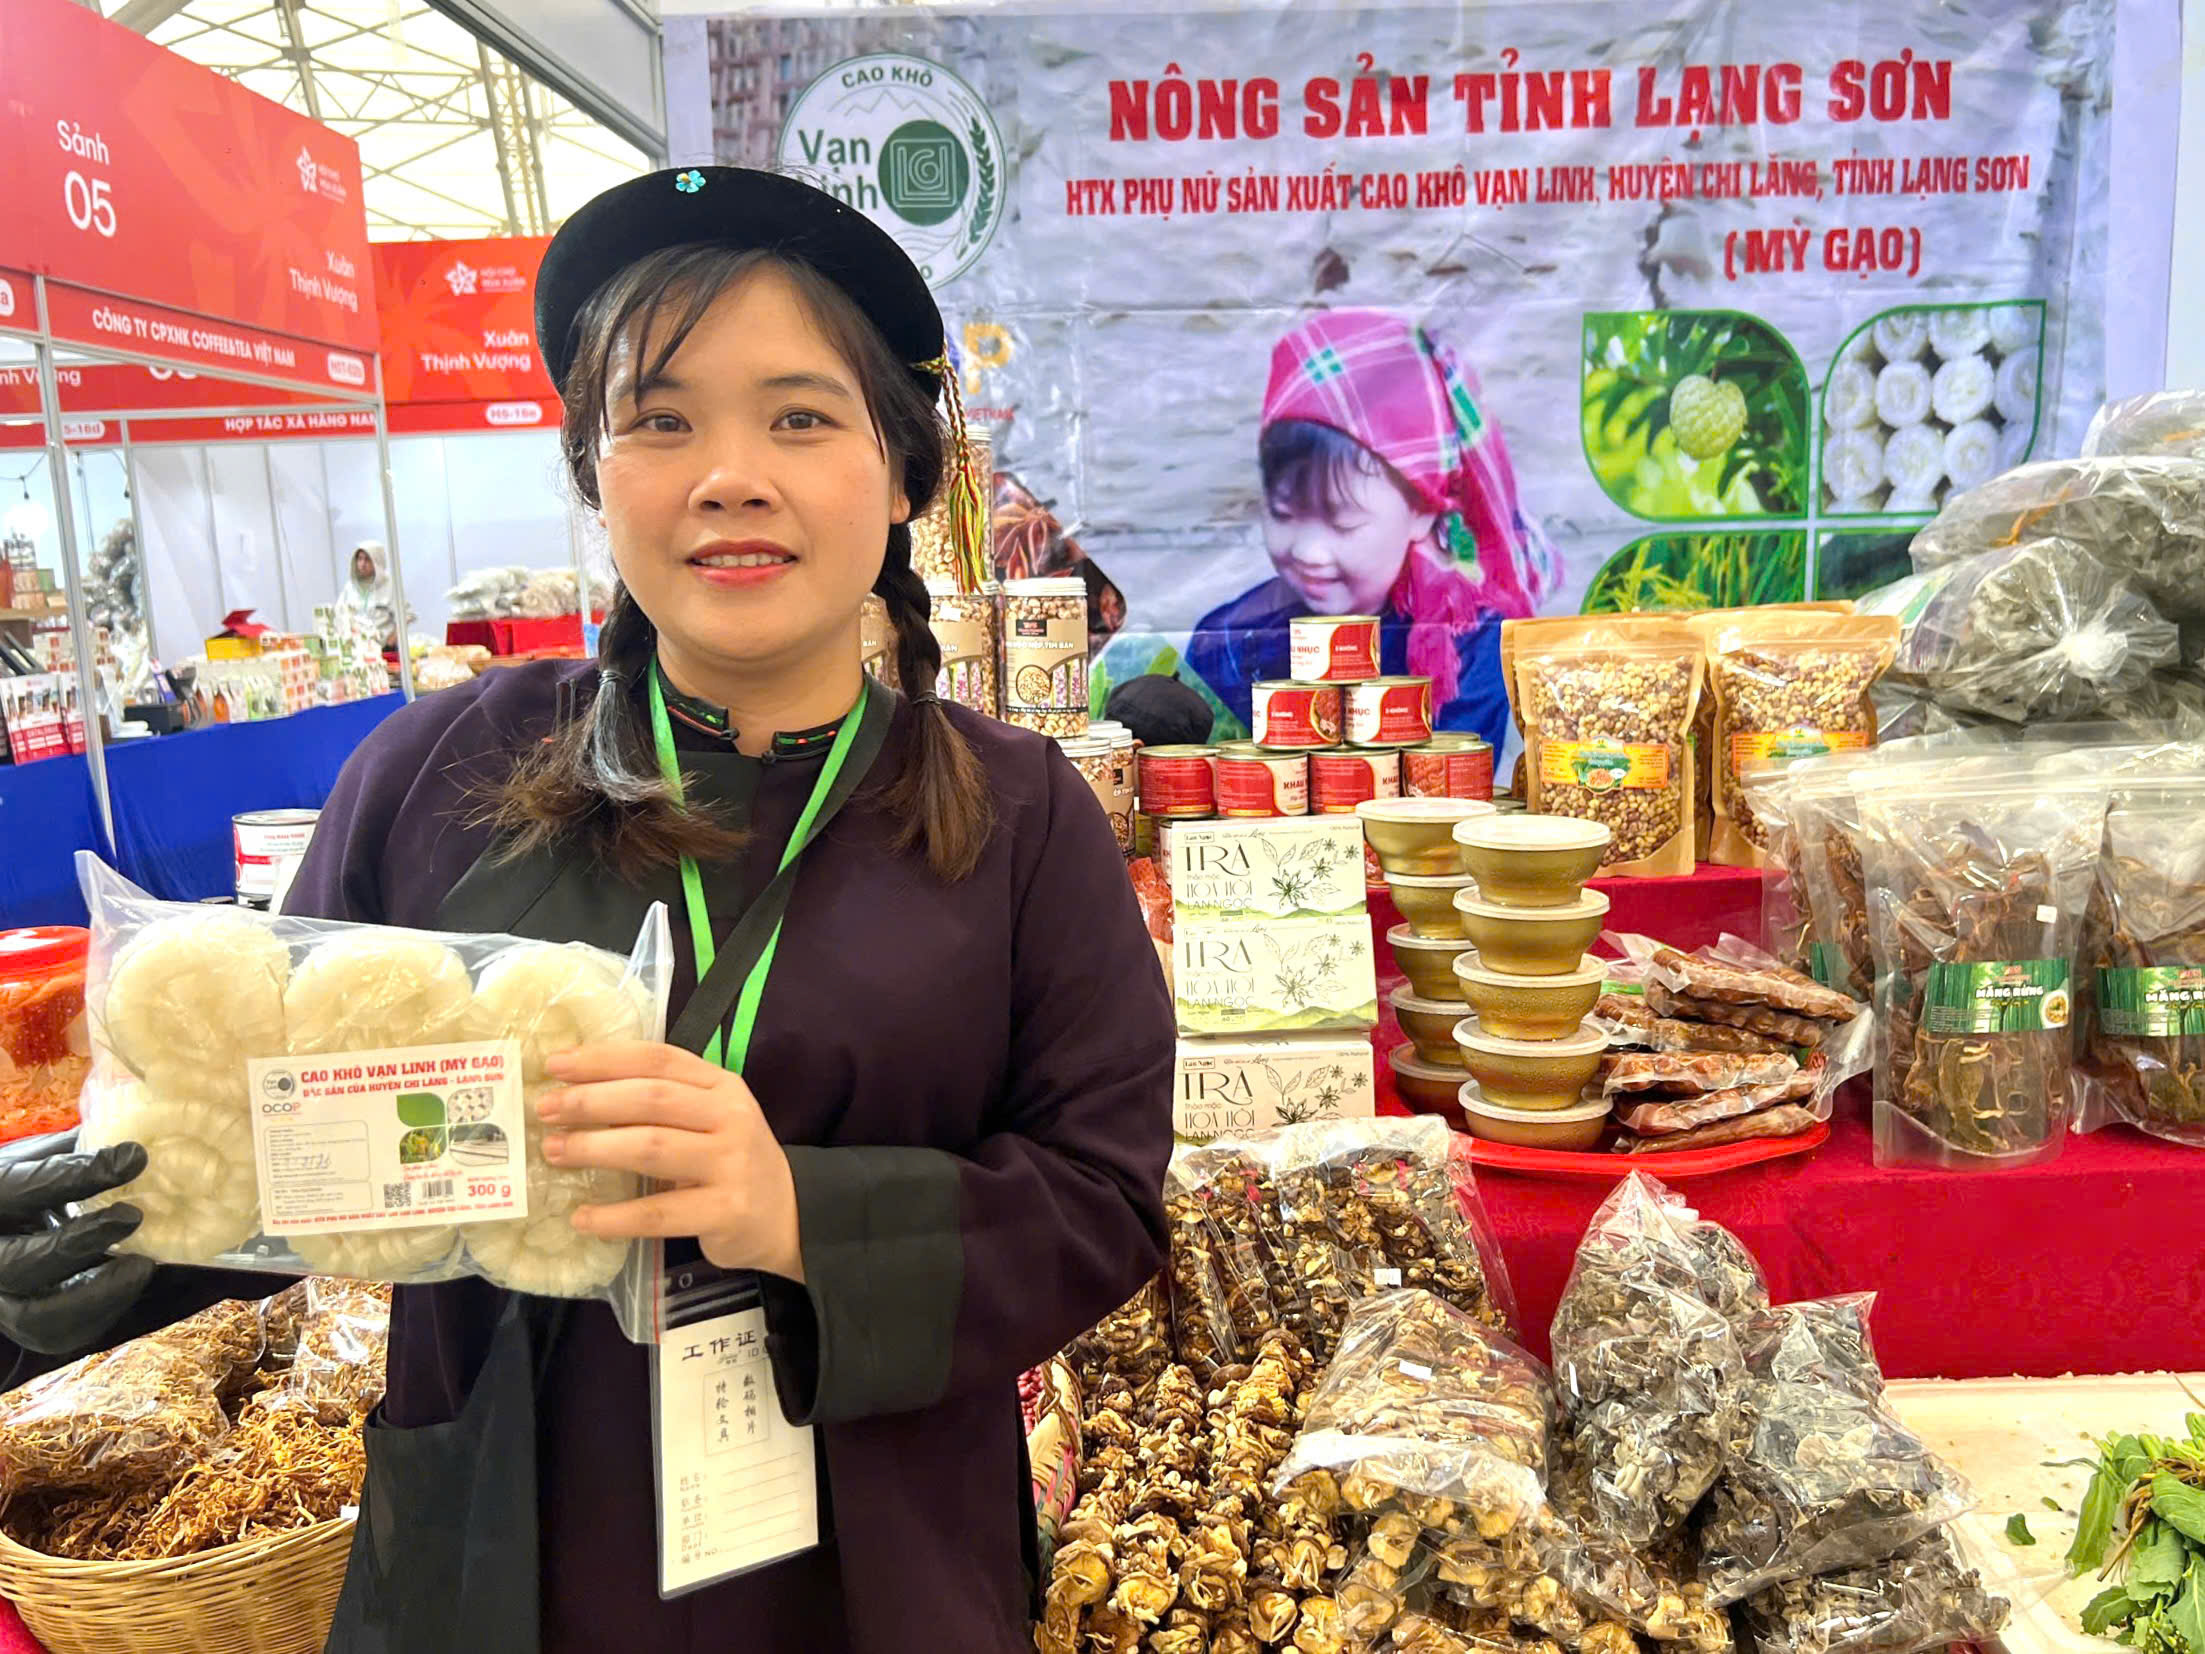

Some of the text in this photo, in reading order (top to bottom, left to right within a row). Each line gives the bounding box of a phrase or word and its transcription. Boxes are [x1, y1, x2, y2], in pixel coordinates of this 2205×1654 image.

[841, 65, 933, 89] CAO KHÔ
[1108, 47, 1952, 142] NÔNG SẢN TỈNH LẠNG SƠN
[56, 119, 110, 166] Sảnh
[797, 129, 871, 174] Vạn
[1066, 179, 1116, 216] HTX
[1122, 178, 1174, 221] PHỤ
[1181, 169, 1222, 214] NỮ
[1227, 165, 1280, 213] SẢN
[1286, 161, 1352, 211] XUẤT
[1360, 173, 1408, 210] CAO
[1416, 163, 1467, 208] KHÔ
[1473, 167, 1528, 211] VẠN
[1608, 156, 1694, 207] HUYỆN
[1701, 162, 1742, 199] CHI
[1749, 152, 1823, 203] LĂNG,
[1833, 148, 1895, 196] TỈNH
[1901, 157, 1968, 201] LẠNG
[1975, 154, 2030, 193] SƠN
[64, 170, 117, 238] 05
[1823, 226, 1921, 279] GẠO)
[92, 307, 131, 335] CÔNG
[133, 317, 147, 338] TY
[272, 348, 296, 367] NAM
[483, 328, 529, 347] Xuân
[420, 351, 532, 375] Thịnh Vượng
[224, 416, 254, 434] HỢP
[301, 1069, 328, 1083] CAO
[333, 1065, 362, 1081] KHÔ
[367, 1064, 397, 1079] VẠN
[401, 1060, 435, 1075] LINH
[262, 1102, 301, 1114] OCOP
[467, 1183, 512, 1198] 300 g
[682, 1330, 758, 1361] 工作证
